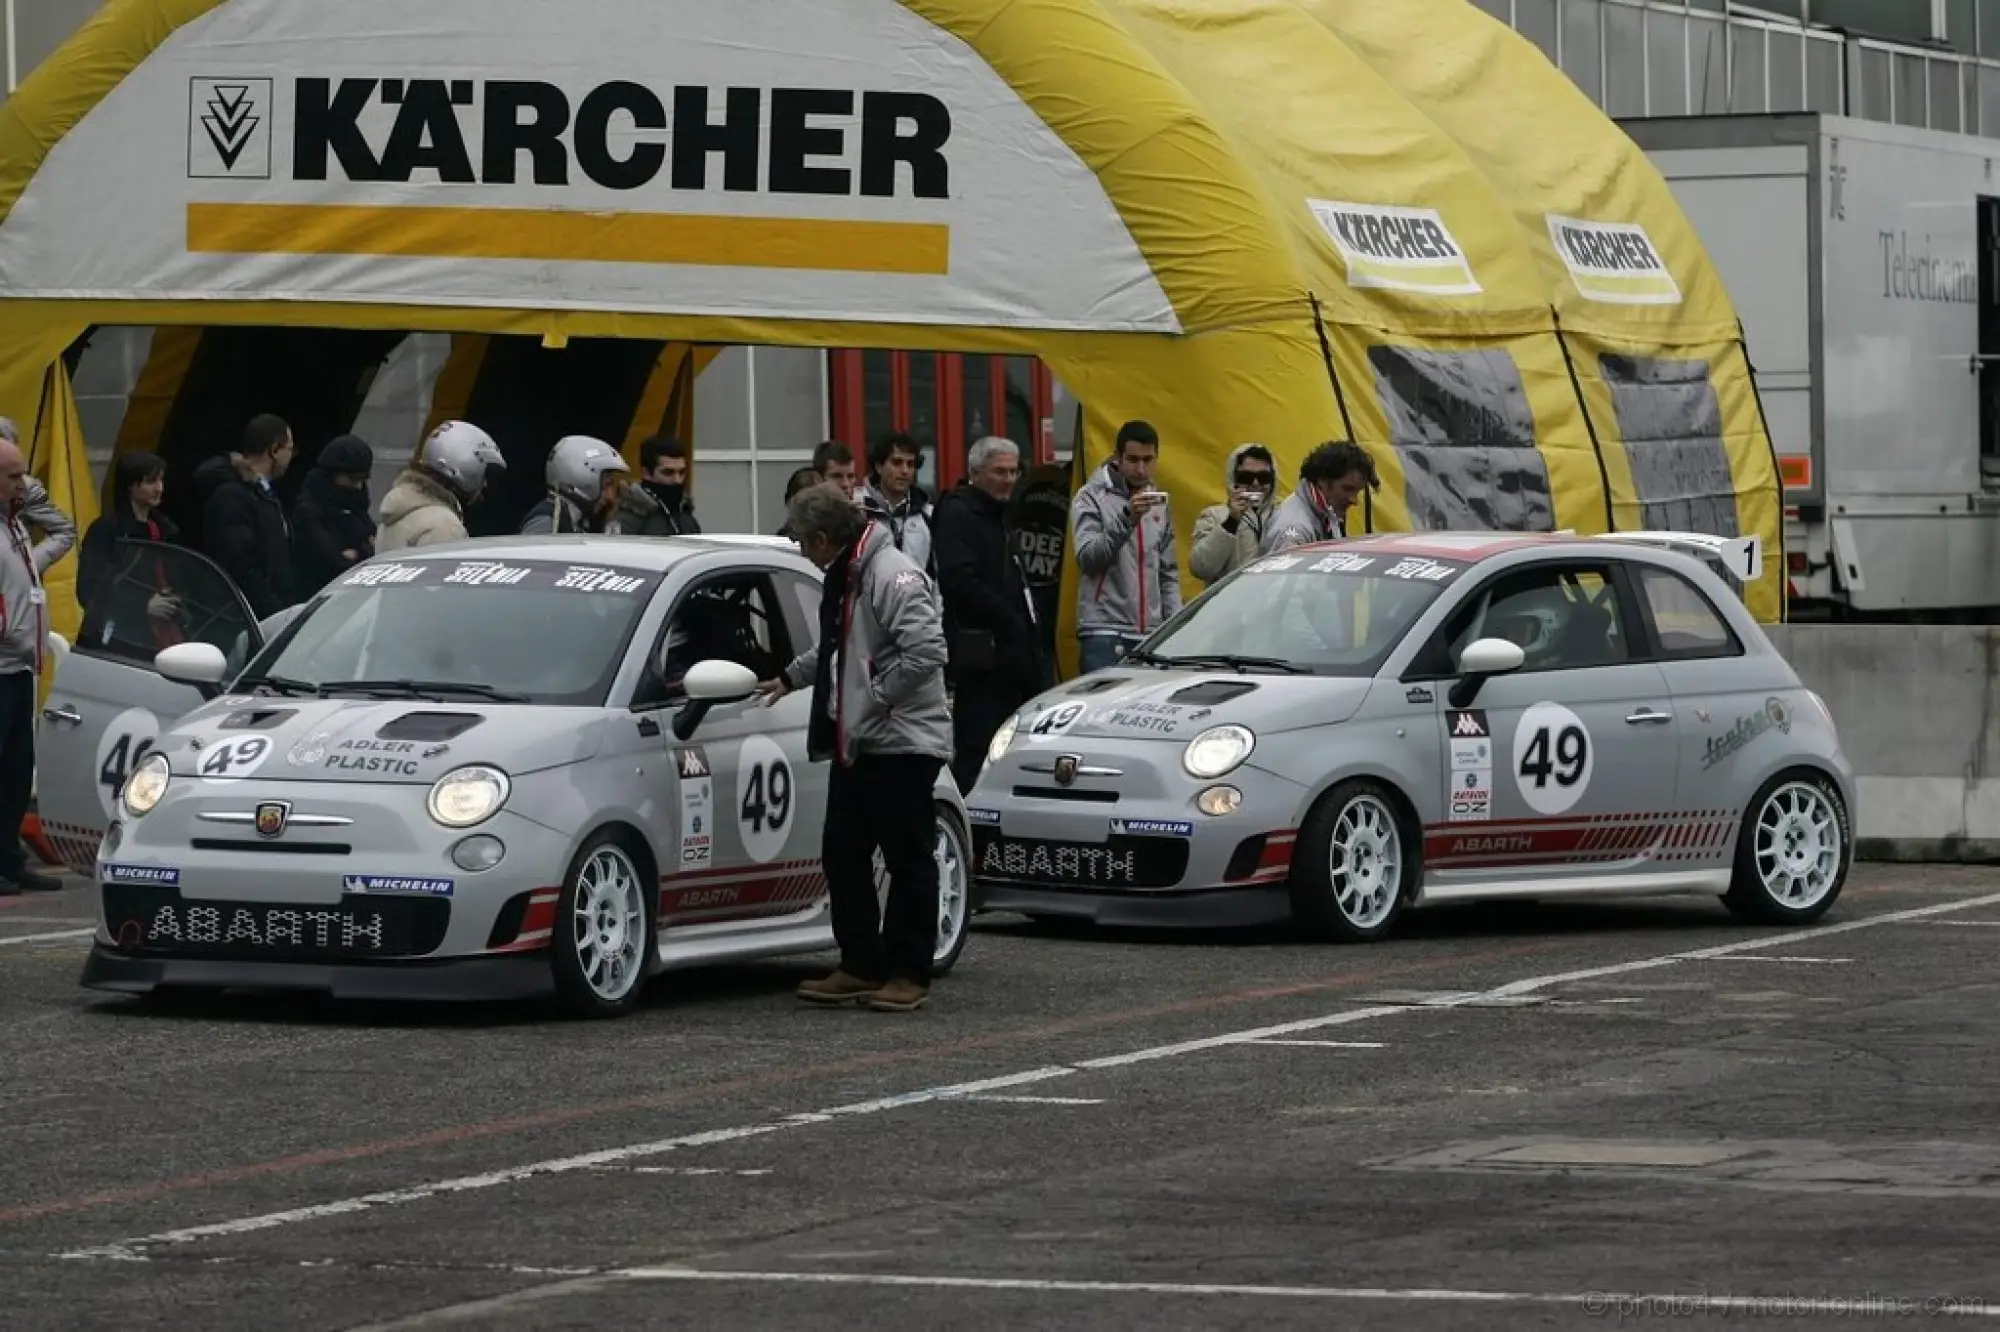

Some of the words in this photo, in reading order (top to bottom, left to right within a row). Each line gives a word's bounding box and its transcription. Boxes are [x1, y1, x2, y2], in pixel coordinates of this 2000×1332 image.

[292, 77, 953, 199] KÄRCHER
[1333, 211, 1458, 259] KÄRCHER
[1562, 225, 1661, 270] KÄRCHER
[1020, 530, 1063, 557] DEE
[1743, 540, 1755, 575] 1
[1032, 704, 1083, 735] 49
[1109, 711, 1178, 734] PLASTIC
[202, 737, 268, 775] 49
[337, 739, 415, 753] ADLER
[1519, 724, 1588, 789] 49
[324, 754, 419, 776] PLASTIC
[741, 758, 792, 834] 49
[1452, 801, 1487, 814] OZ
[1127, 821, 1189, 834] MICHELIN
[1452, 835, 1533, 853] ABARTH
[114, 867, 176, 882] MICHELIN
[983, 842, 1134, 881] ABARTH
[368, 878, 450, 893] MICHELIN
[678, 887, 741, 907] ABARTH
[148, 905, 383, 949] ABARTH
